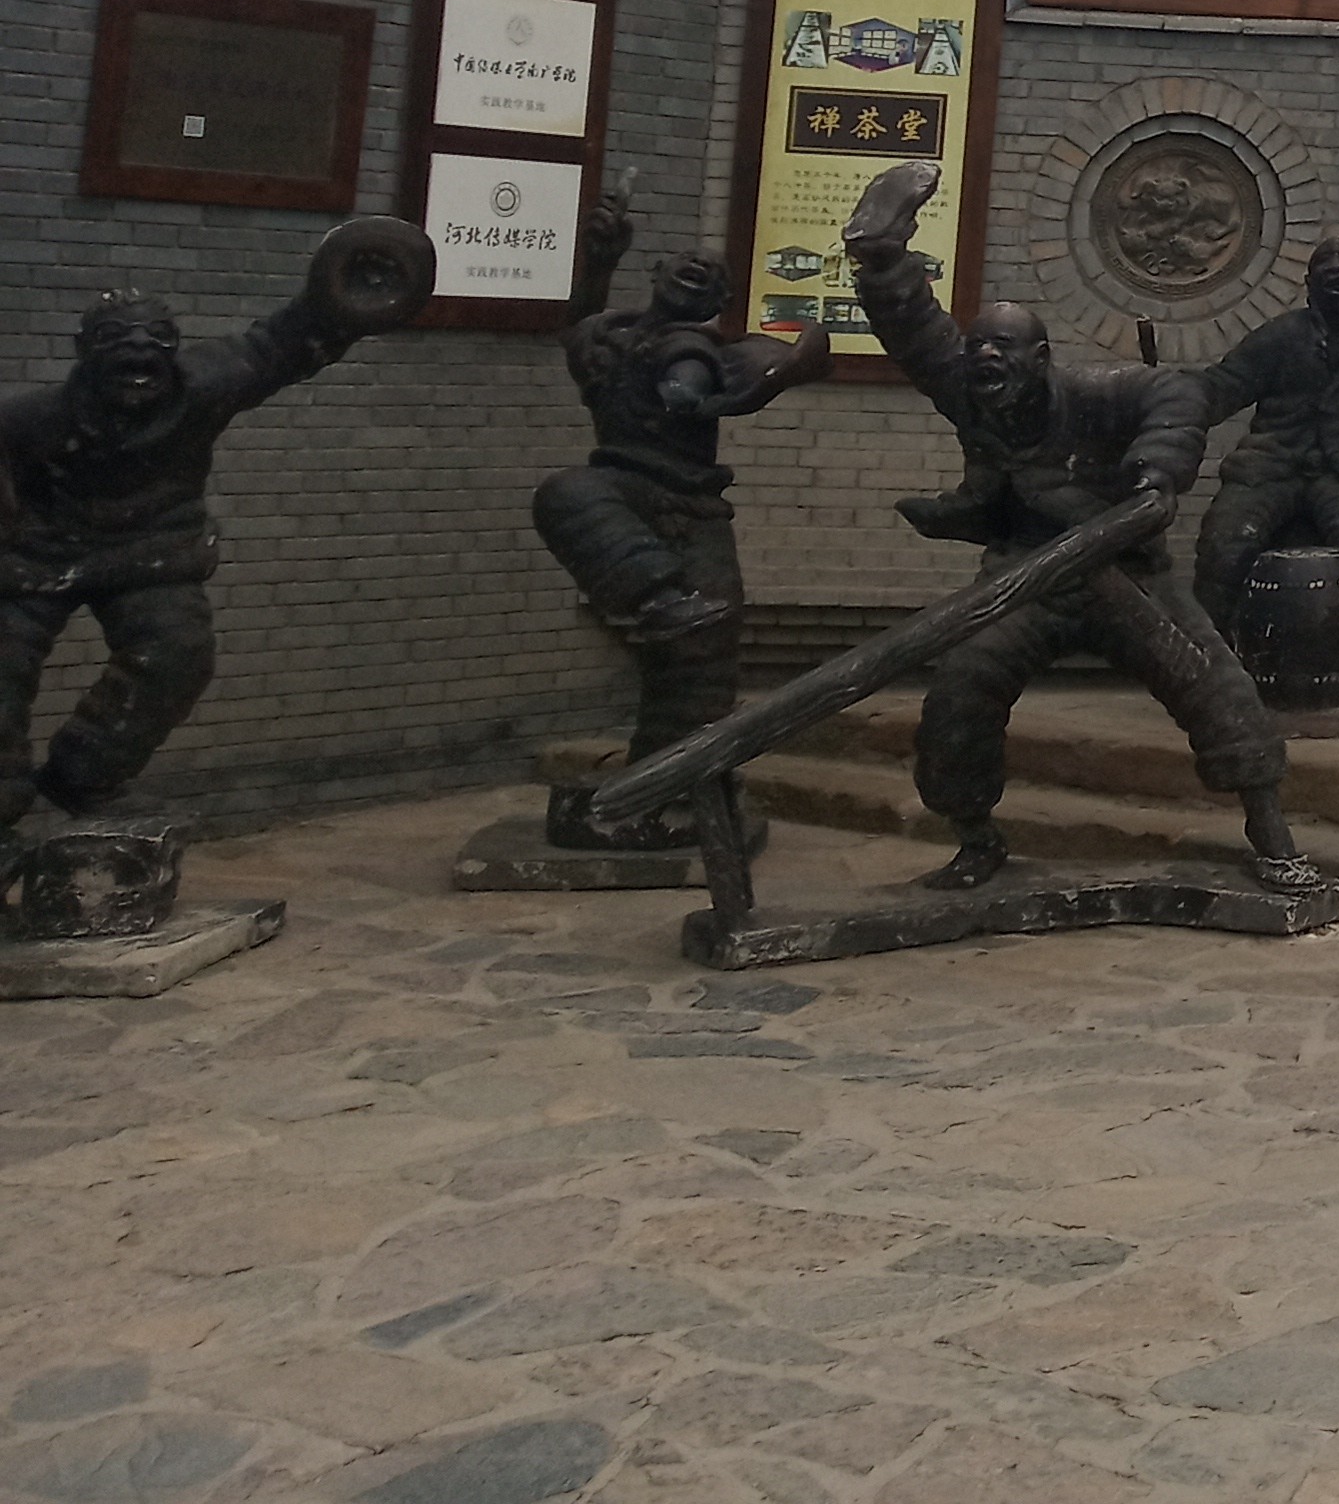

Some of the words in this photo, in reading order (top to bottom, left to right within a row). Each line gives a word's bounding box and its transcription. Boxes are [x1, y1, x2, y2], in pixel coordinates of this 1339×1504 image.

[480, 95, 547, 113] 实践教学基地
[807, 104, 930, 144] 禅茶堂
[445, 222, 557, 251] 河北传媒学院
[466, 265, 533, 281] 实践教学基地
